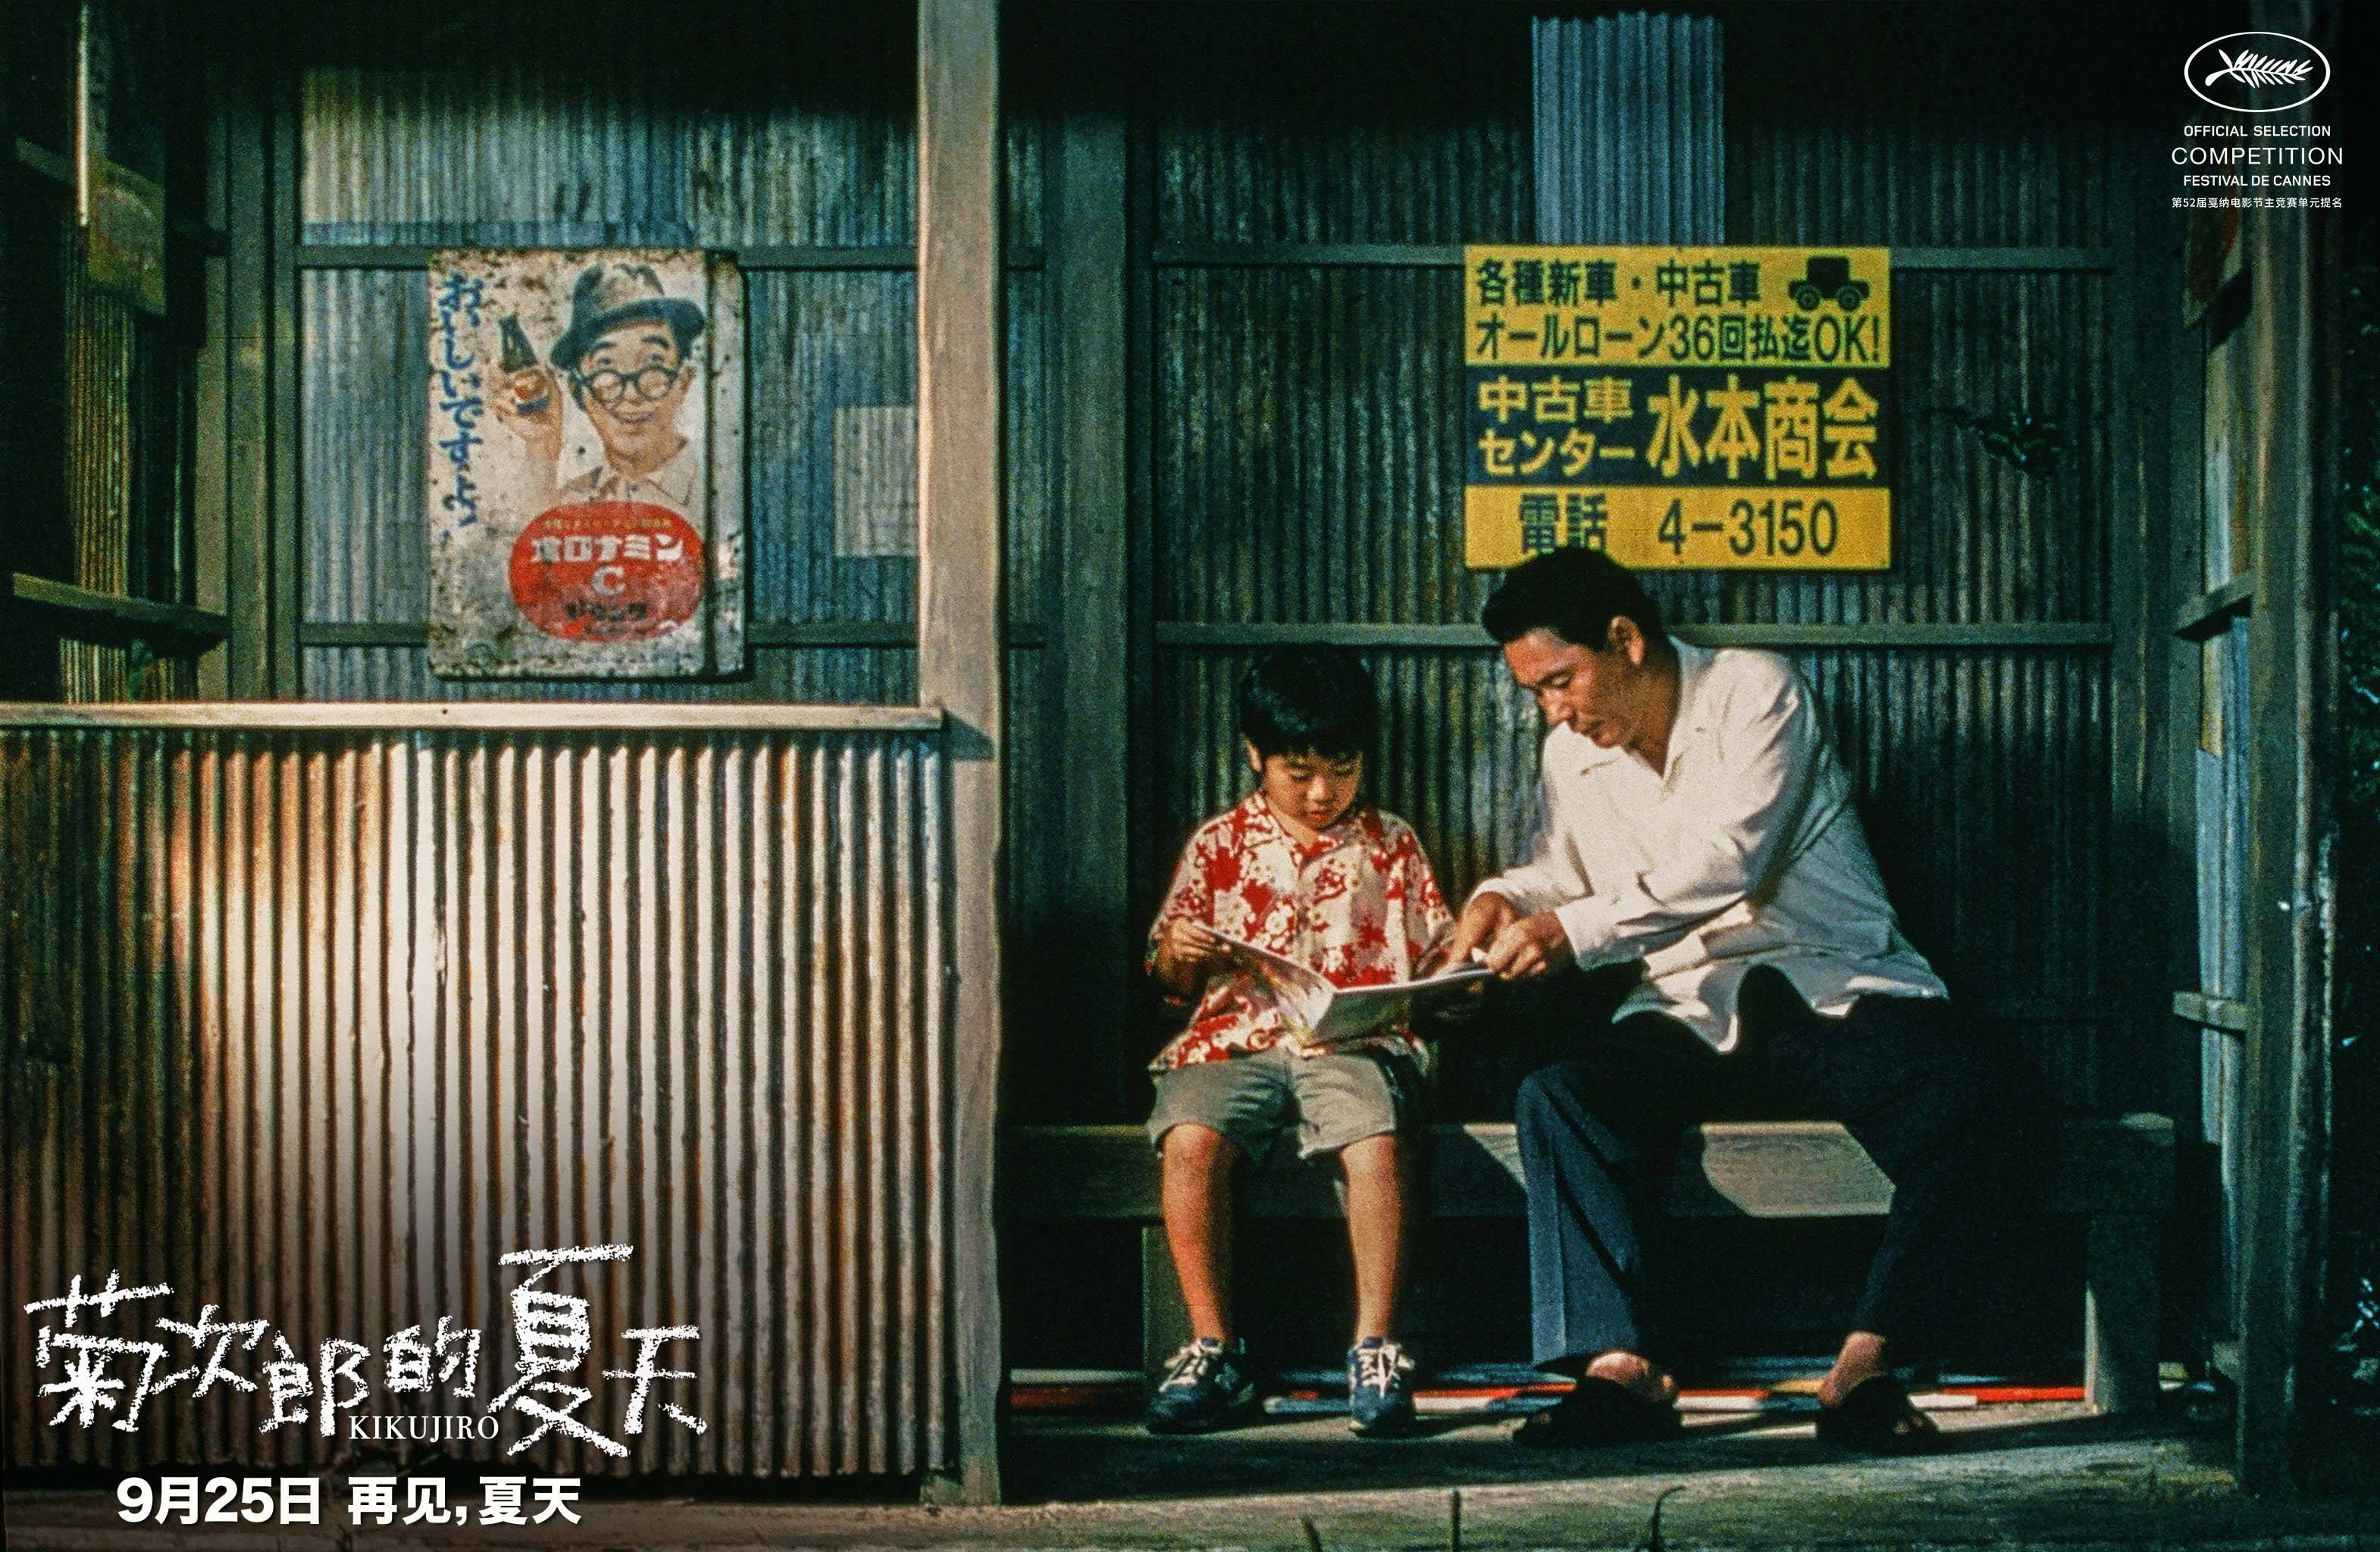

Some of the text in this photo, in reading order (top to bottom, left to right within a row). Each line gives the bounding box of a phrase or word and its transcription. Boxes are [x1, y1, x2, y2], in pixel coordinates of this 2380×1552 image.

[1479, 376, 1633, 423] 中古車
[1646, 374, 1878, 480] 水本商会
[1478, 428, 1636, 477] センター
[1520, 493, 1608, 554] 電話
[590, 565, 627, 597] C
